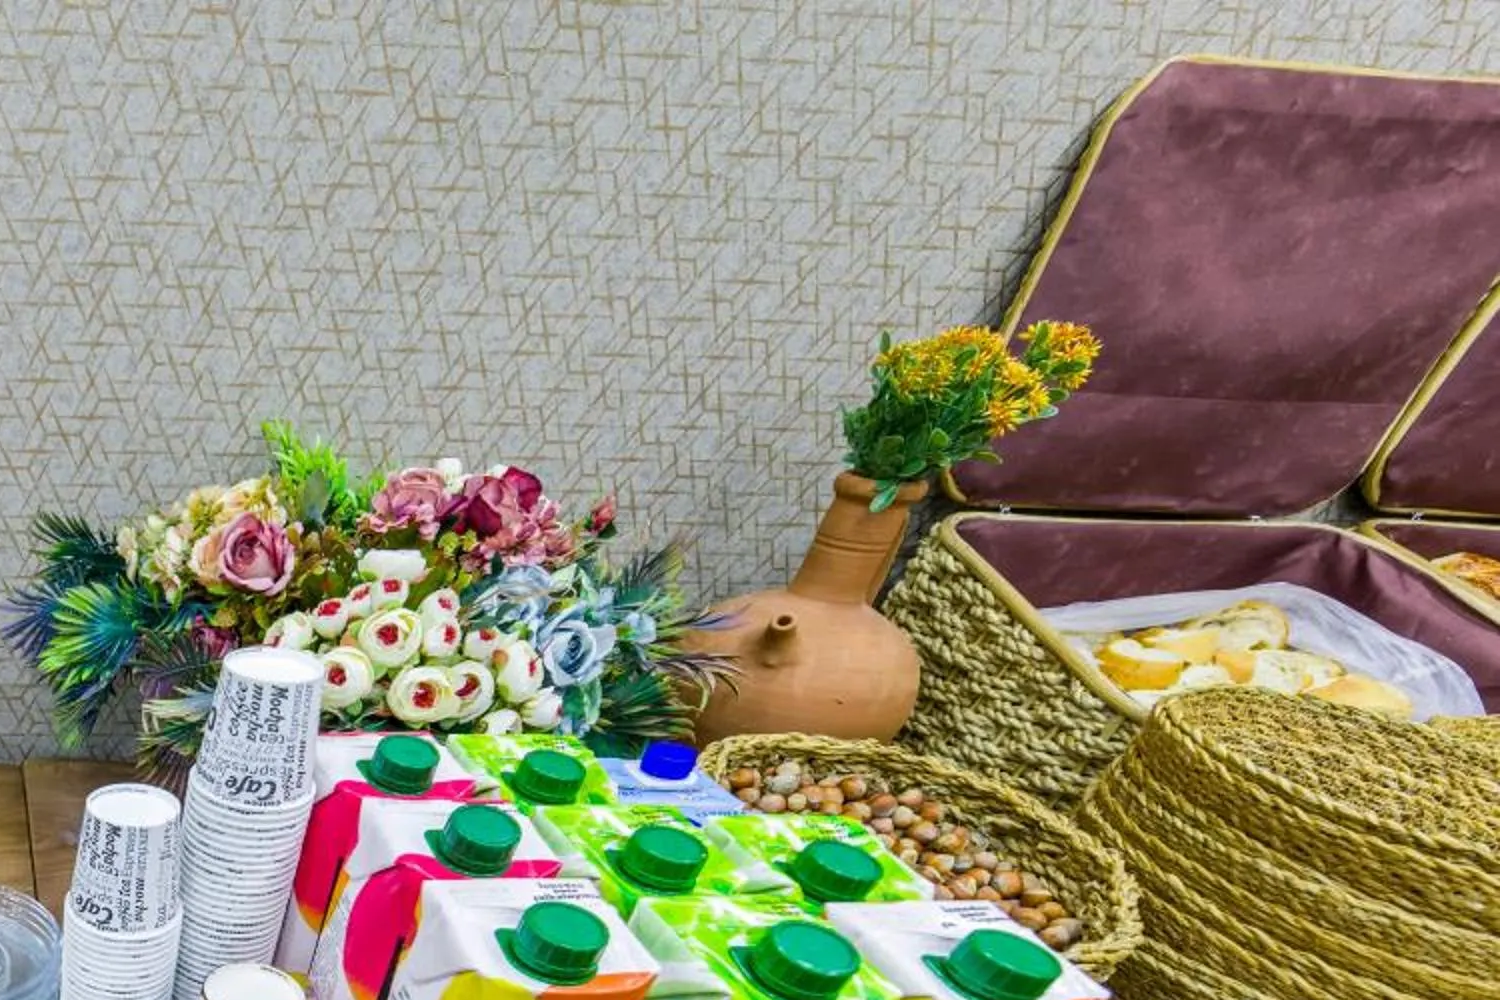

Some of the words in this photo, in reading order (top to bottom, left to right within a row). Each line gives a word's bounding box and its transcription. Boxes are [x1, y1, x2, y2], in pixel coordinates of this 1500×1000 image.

[246, 683, 264, 742] mocha
[264, 684, 289, 733] Mocha
[225, 775, 277, 801] Cafe
[75, 895, 113, 925] Cafe
